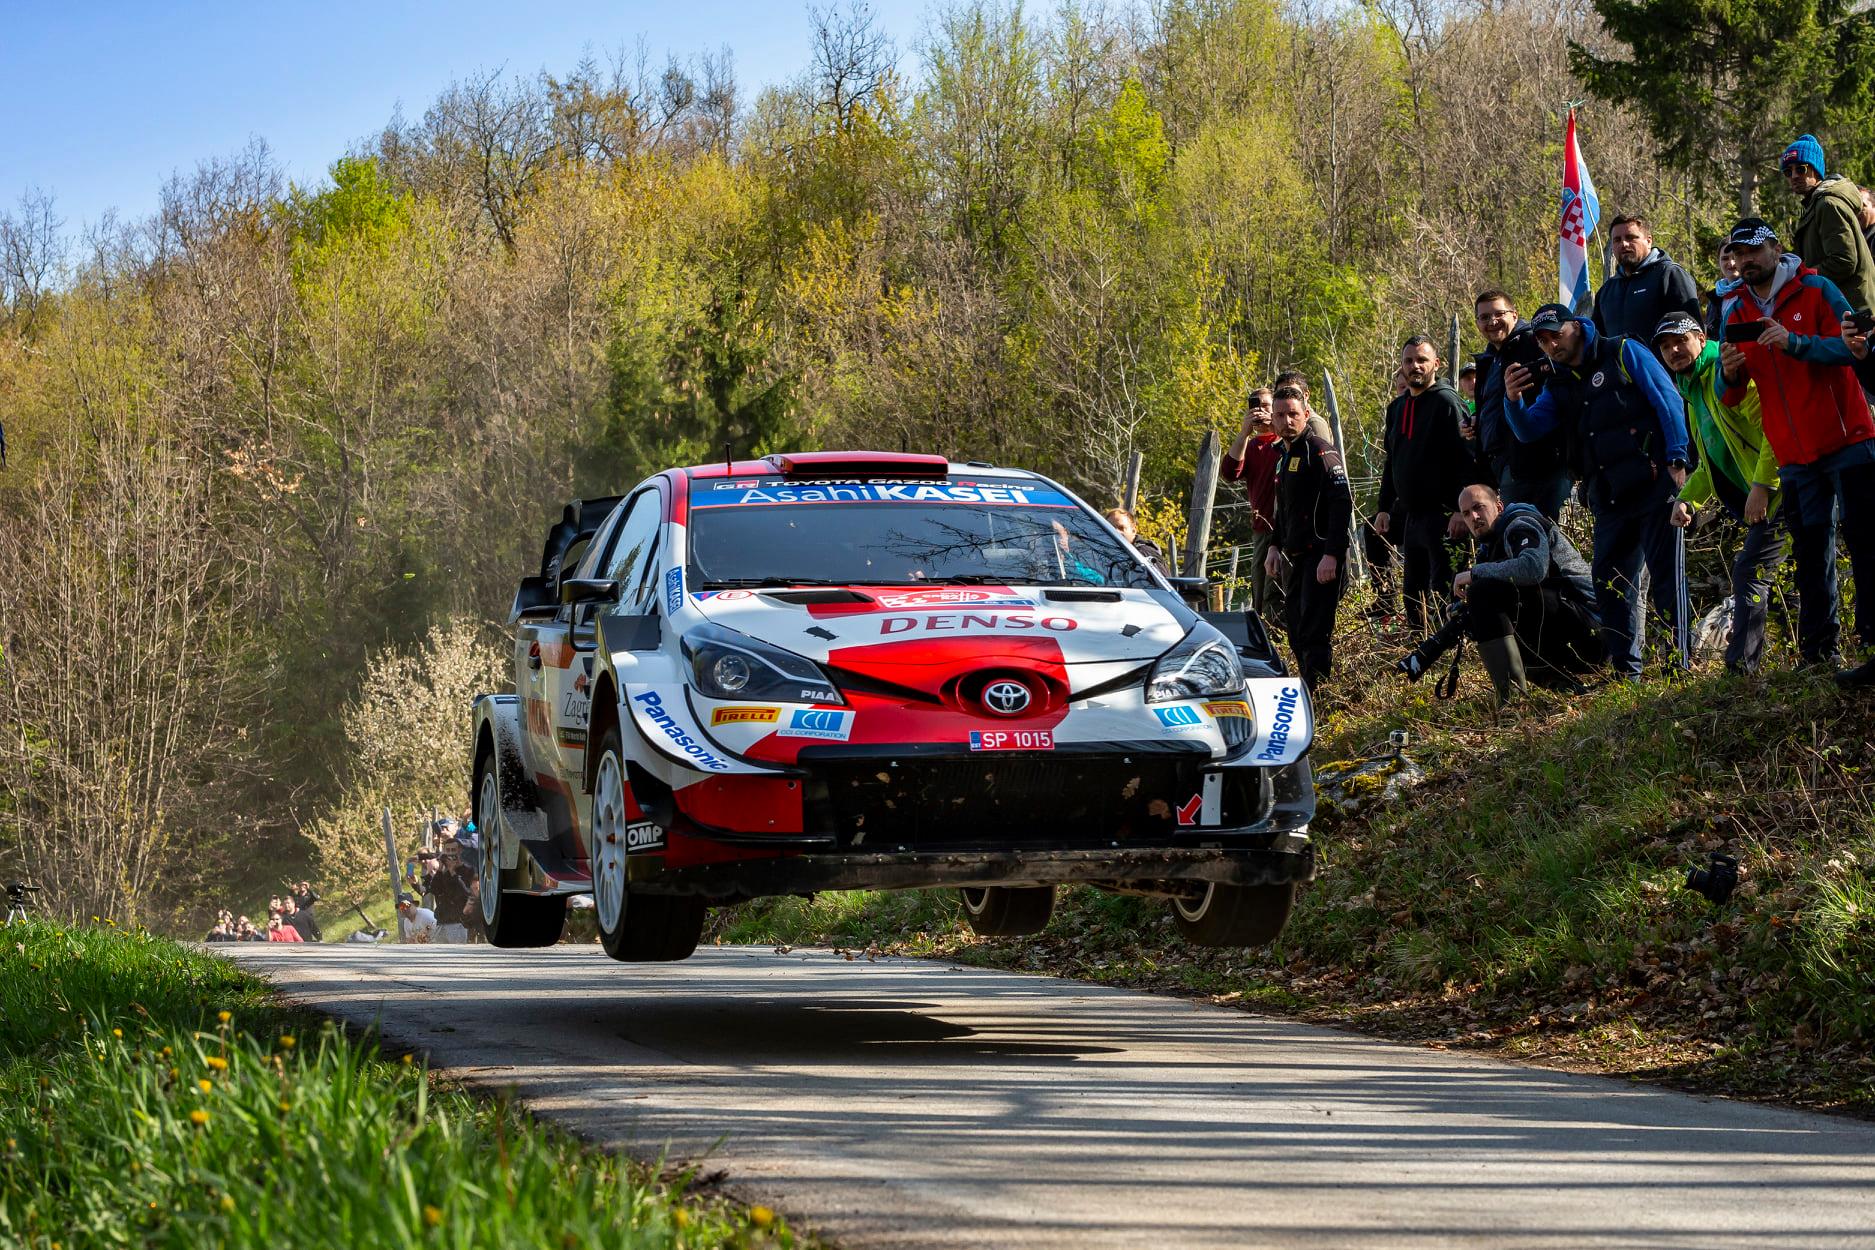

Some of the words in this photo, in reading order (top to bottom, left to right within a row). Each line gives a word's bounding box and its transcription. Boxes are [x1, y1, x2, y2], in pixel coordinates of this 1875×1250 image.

[880, 615, 1078, 634] DENSO
[801, 689, 835, 700] PIAA
[1154, 689, 1180, 699] PIAA
[715, 708, 776, 722] PIRELLI
[634, 691, 728, 770] Panasonic
[1256, 687, 1299, 761] Panasonic
[795, 730, 847, 739] CORPORATION
[983, 733, 1008, 747] SP
[1014, 732, 1051, 747] 1015
[628, 825, 662, 846] OMP
